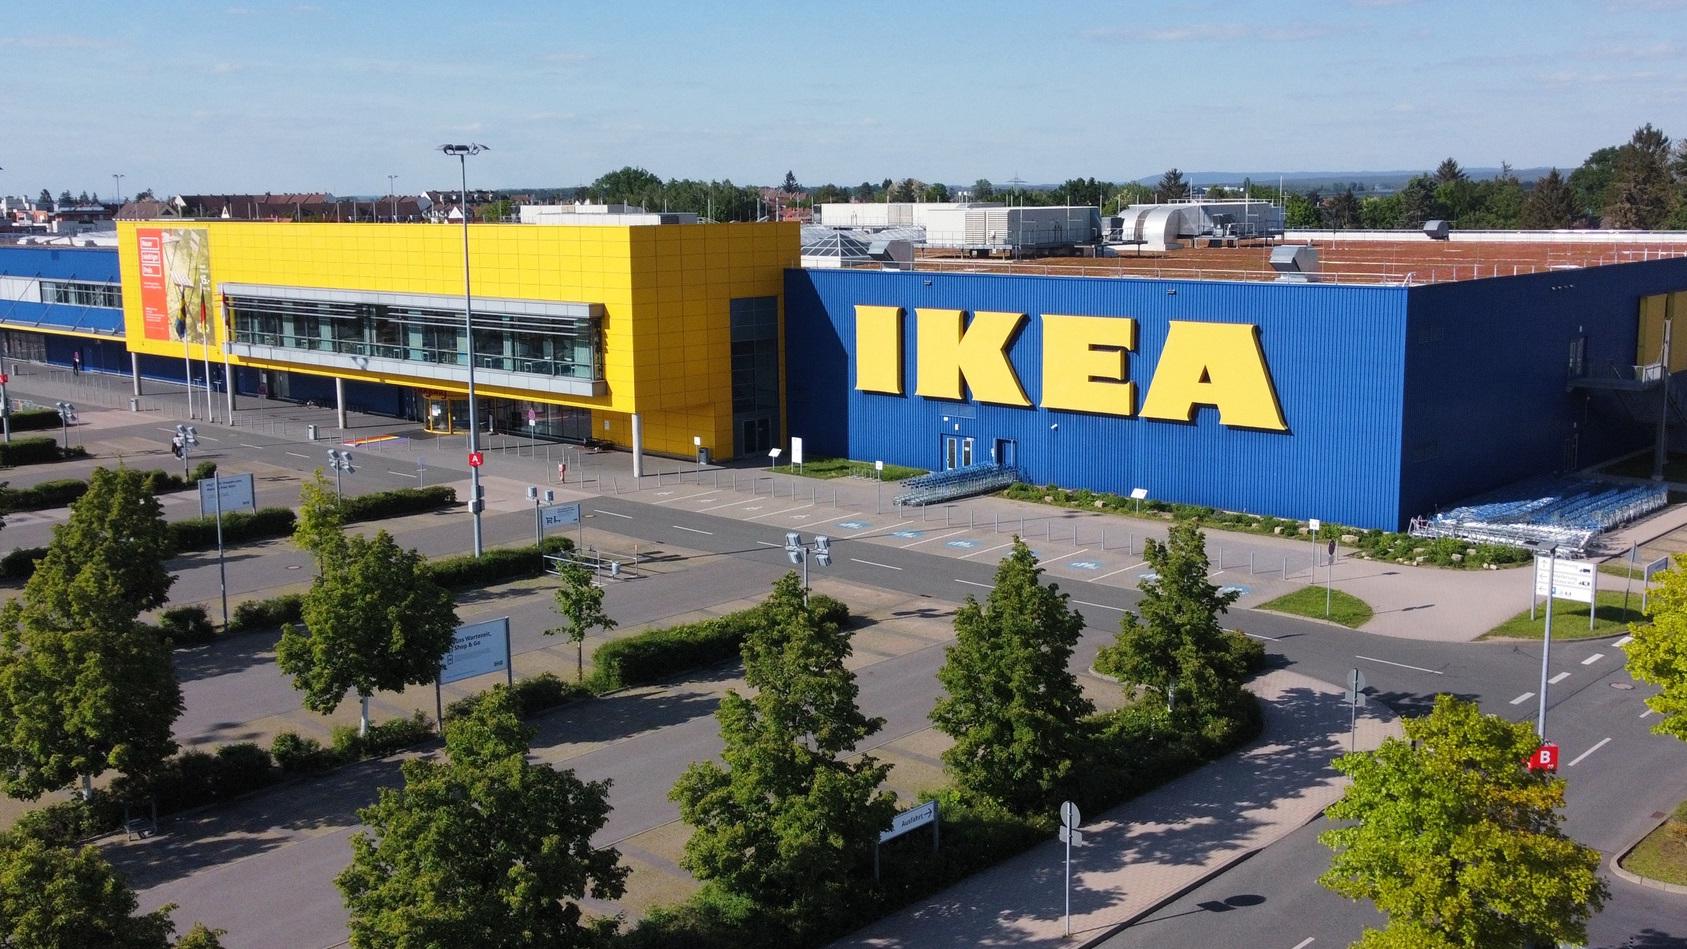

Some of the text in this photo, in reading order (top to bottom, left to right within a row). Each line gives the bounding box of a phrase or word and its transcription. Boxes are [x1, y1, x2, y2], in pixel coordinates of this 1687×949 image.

[853, 304, 1289, 431] IKEA
[472, 455, 479, 463] A
[1540, 750, 1551, 764] B
[902, 814, 923, 827] Ausfahrt
